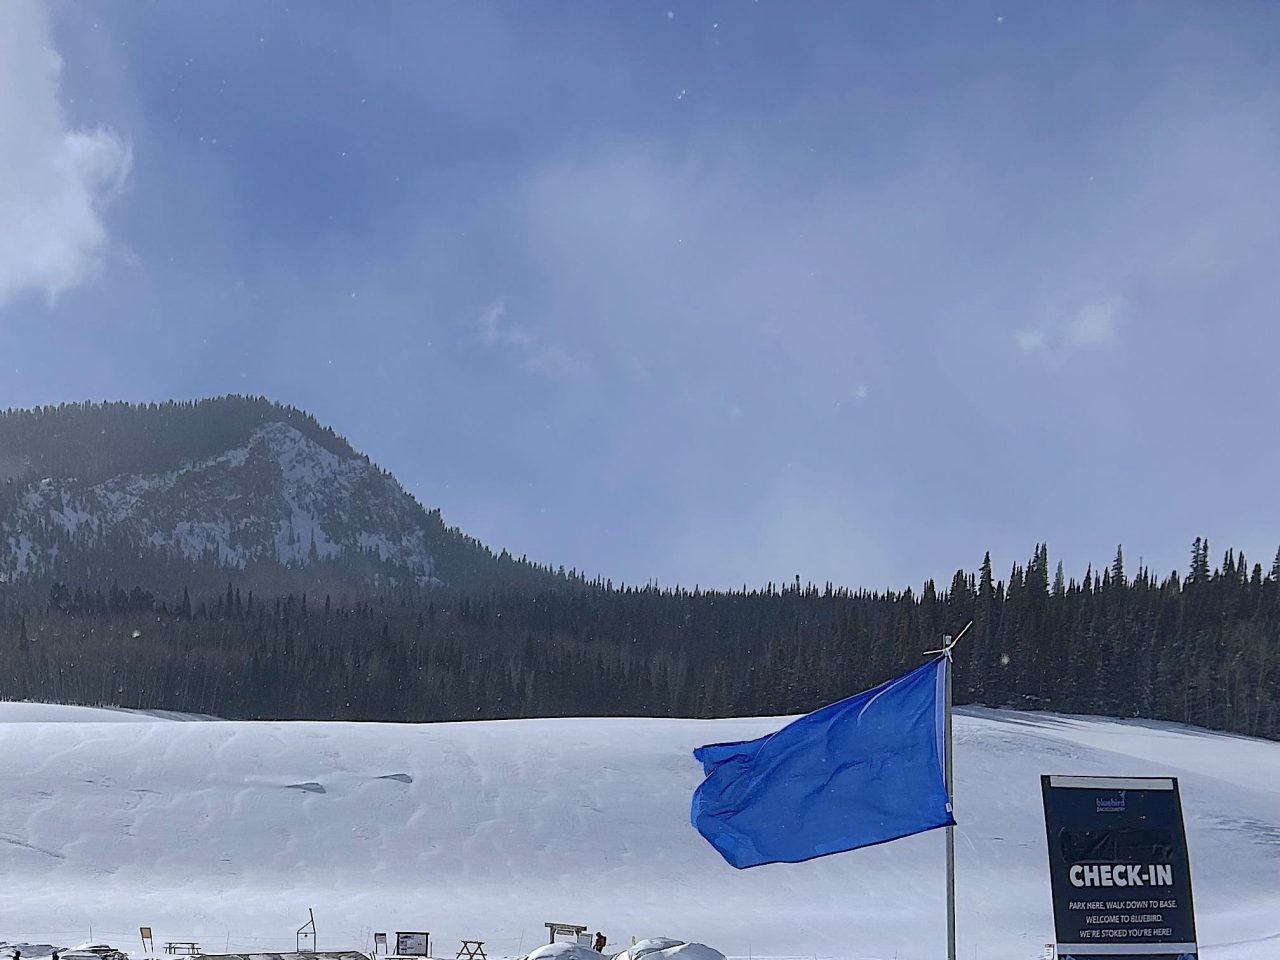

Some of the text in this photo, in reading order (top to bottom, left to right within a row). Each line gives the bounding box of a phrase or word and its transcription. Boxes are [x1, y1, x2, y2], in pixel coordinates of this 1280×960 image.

[1070, 865, 1173, 887] CHECK-IN
[1069, 902, 1086, 910] PARK
[1106, 901, 1126, 909] WALK
[1086, 915, 1120, 923] WELCOME
[1101, 929, 1128, 937] STOKED
[1153, 928, 1172, 936] HERE!
